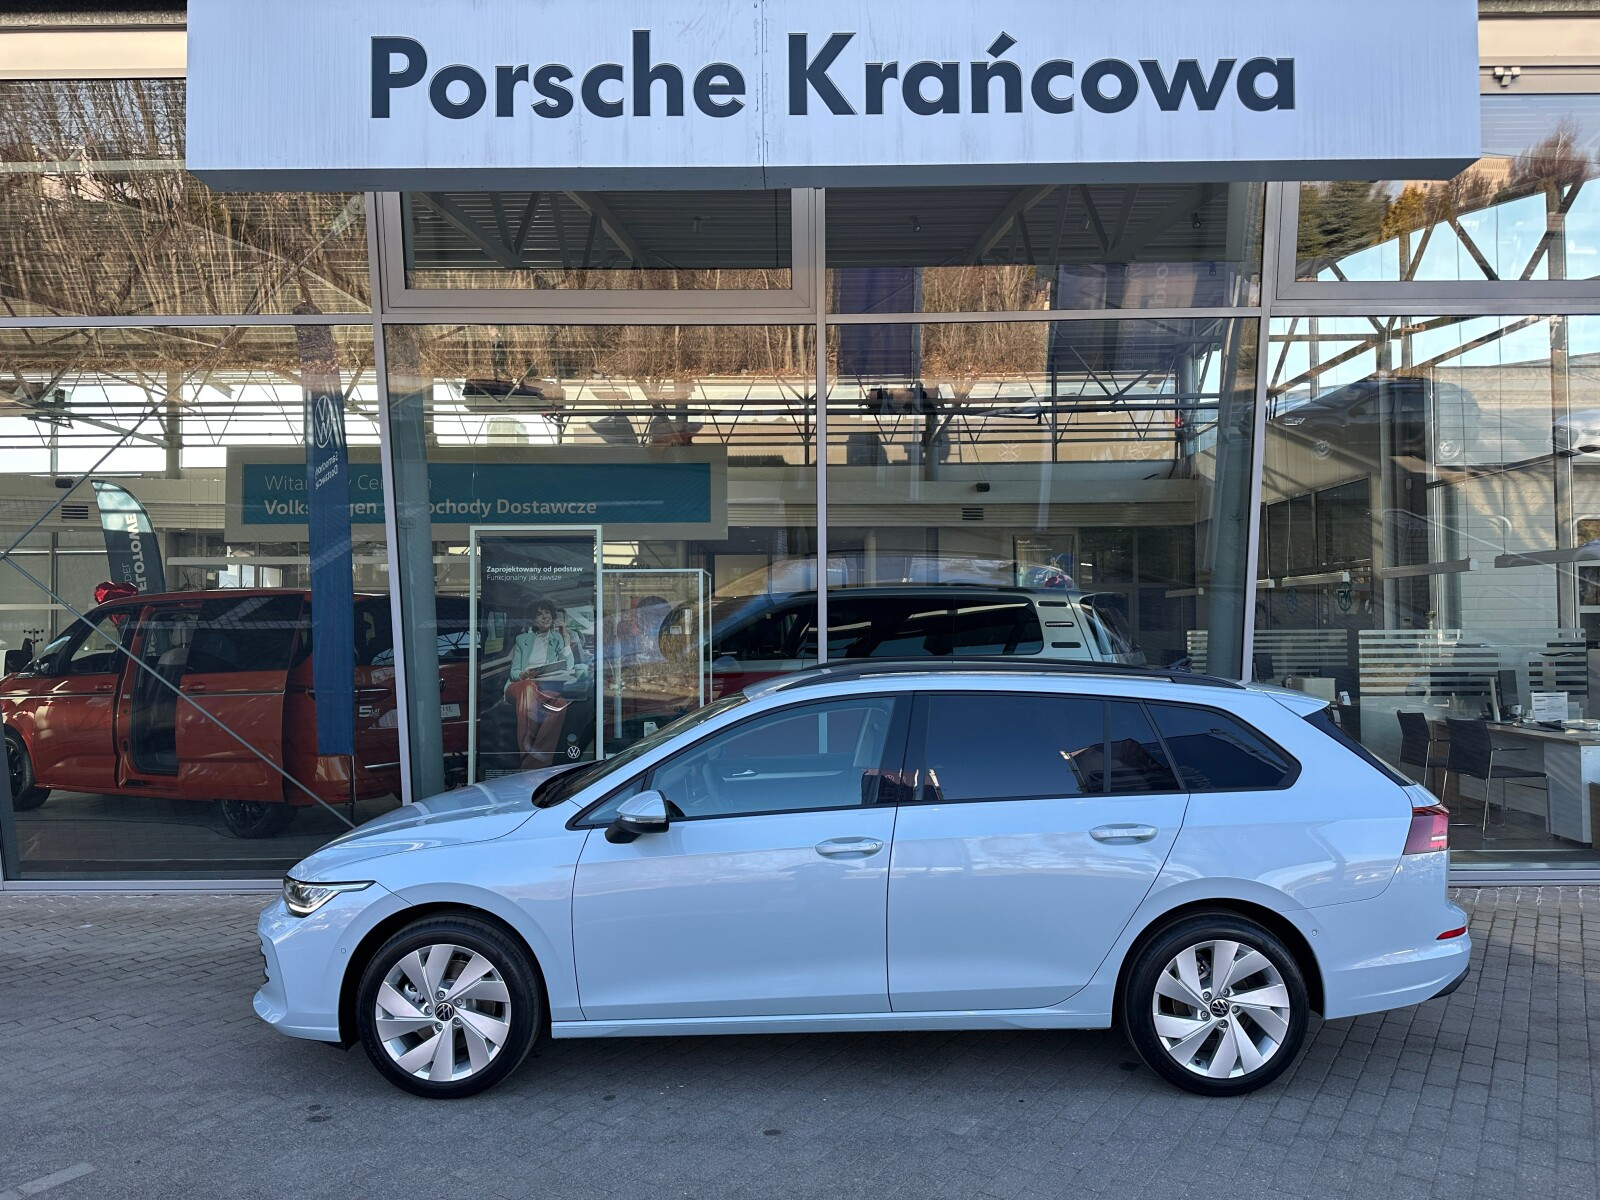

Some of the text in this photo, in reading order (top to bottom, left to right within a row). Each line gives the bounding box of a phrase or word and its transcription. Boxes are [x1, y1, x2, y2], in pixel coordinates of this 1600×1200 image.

[370, 30, 1296, 118] Porsche Krańcowa
[496, 499, 597, 514] Dostawcze
[486, 565, 584, 574] Zaprojektowany od podstaw
[486, 574, 528, 582] Funkcjonalny
[528, 574, 538, 582] jak
